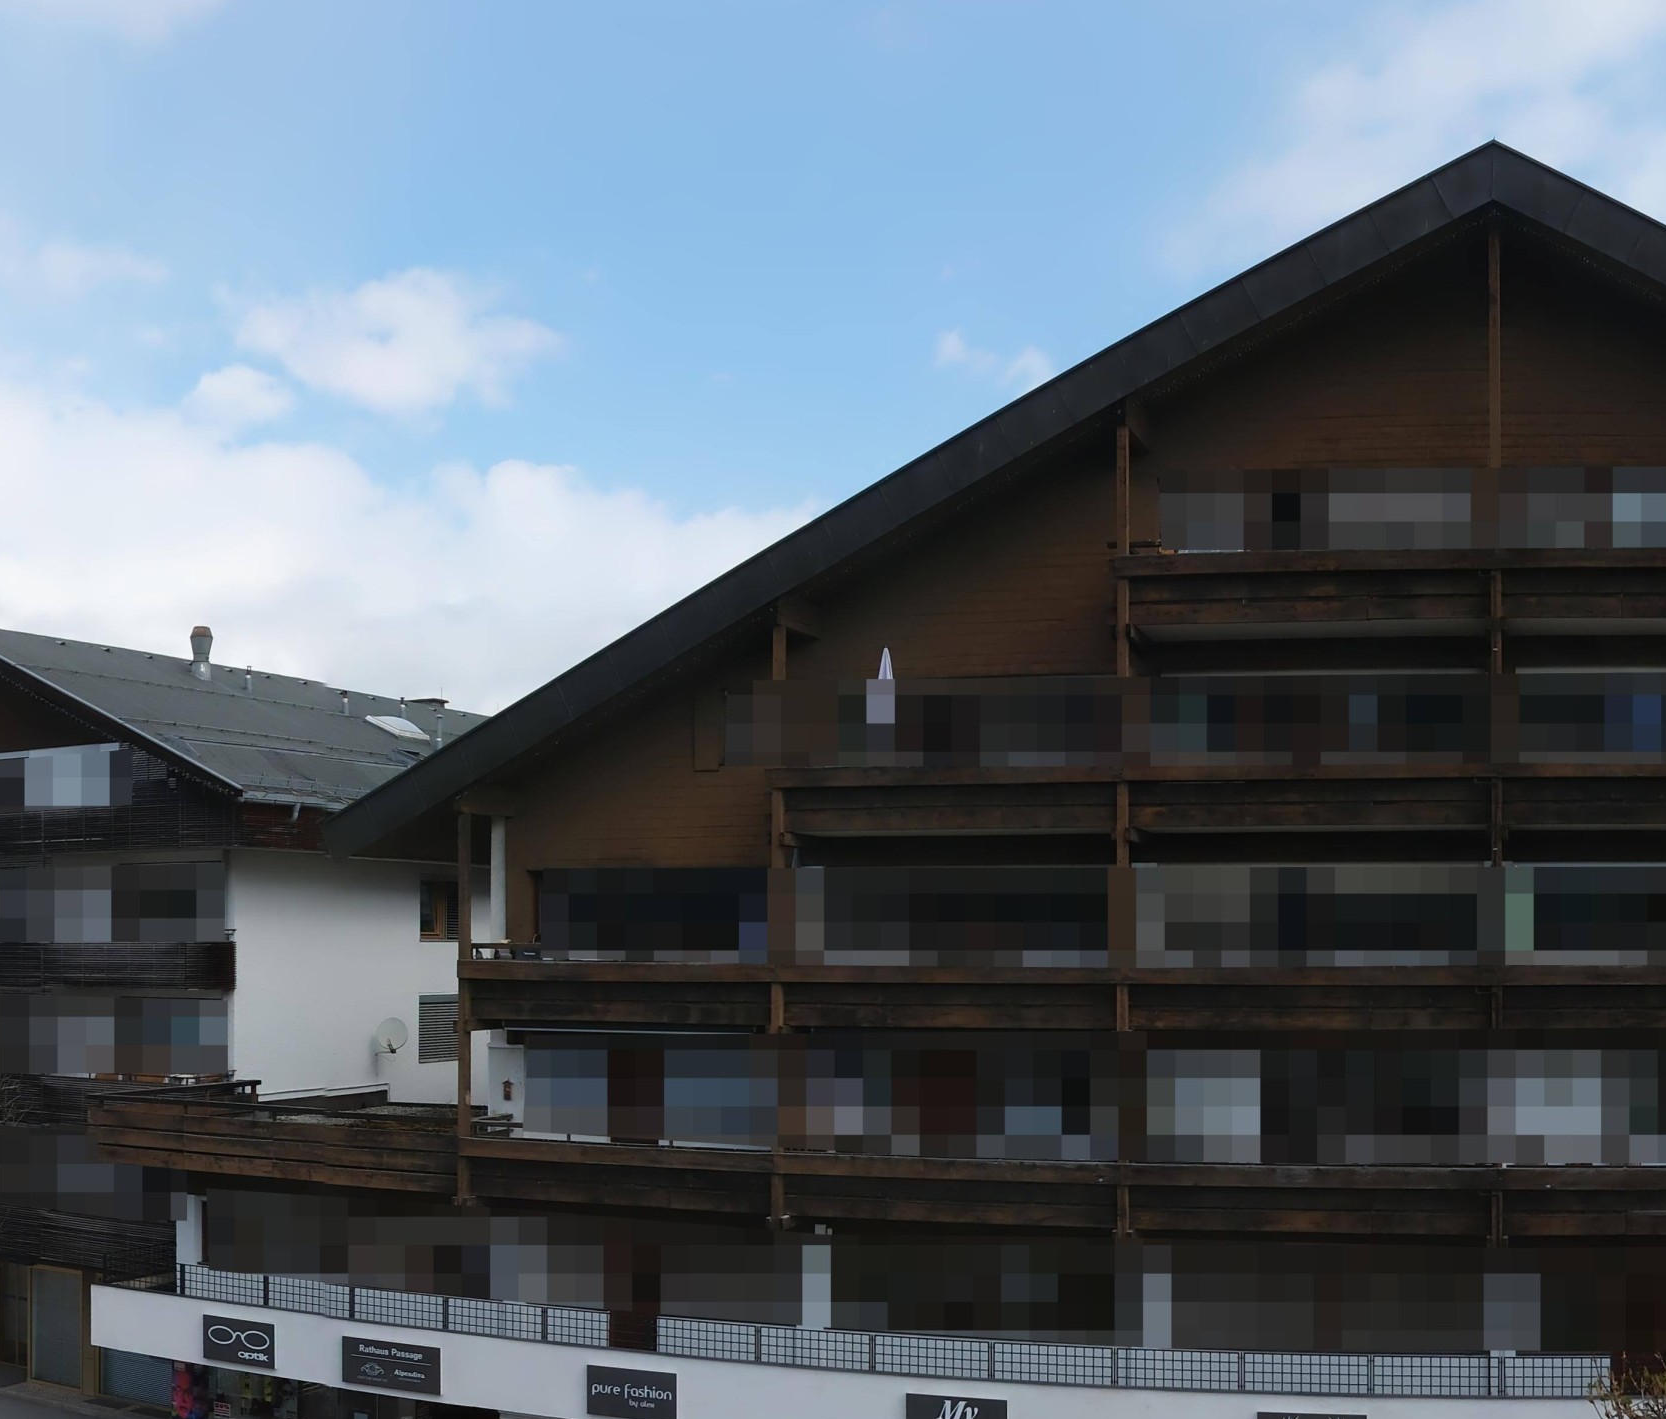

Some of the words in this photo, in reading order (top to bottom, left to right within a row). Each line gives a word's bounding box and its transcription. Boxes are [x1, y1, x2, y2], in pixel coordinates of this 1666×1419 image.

[237, 1350, 269, 1362] optik
[359, 1344, 389, 1356] Rathaus
[391, 1348, 423, 1361] Passage
[591, 1383, 621, 1396] pure
[624, 1383, 673, 1401] fashion
[628, 1398, 638, 1409] by
